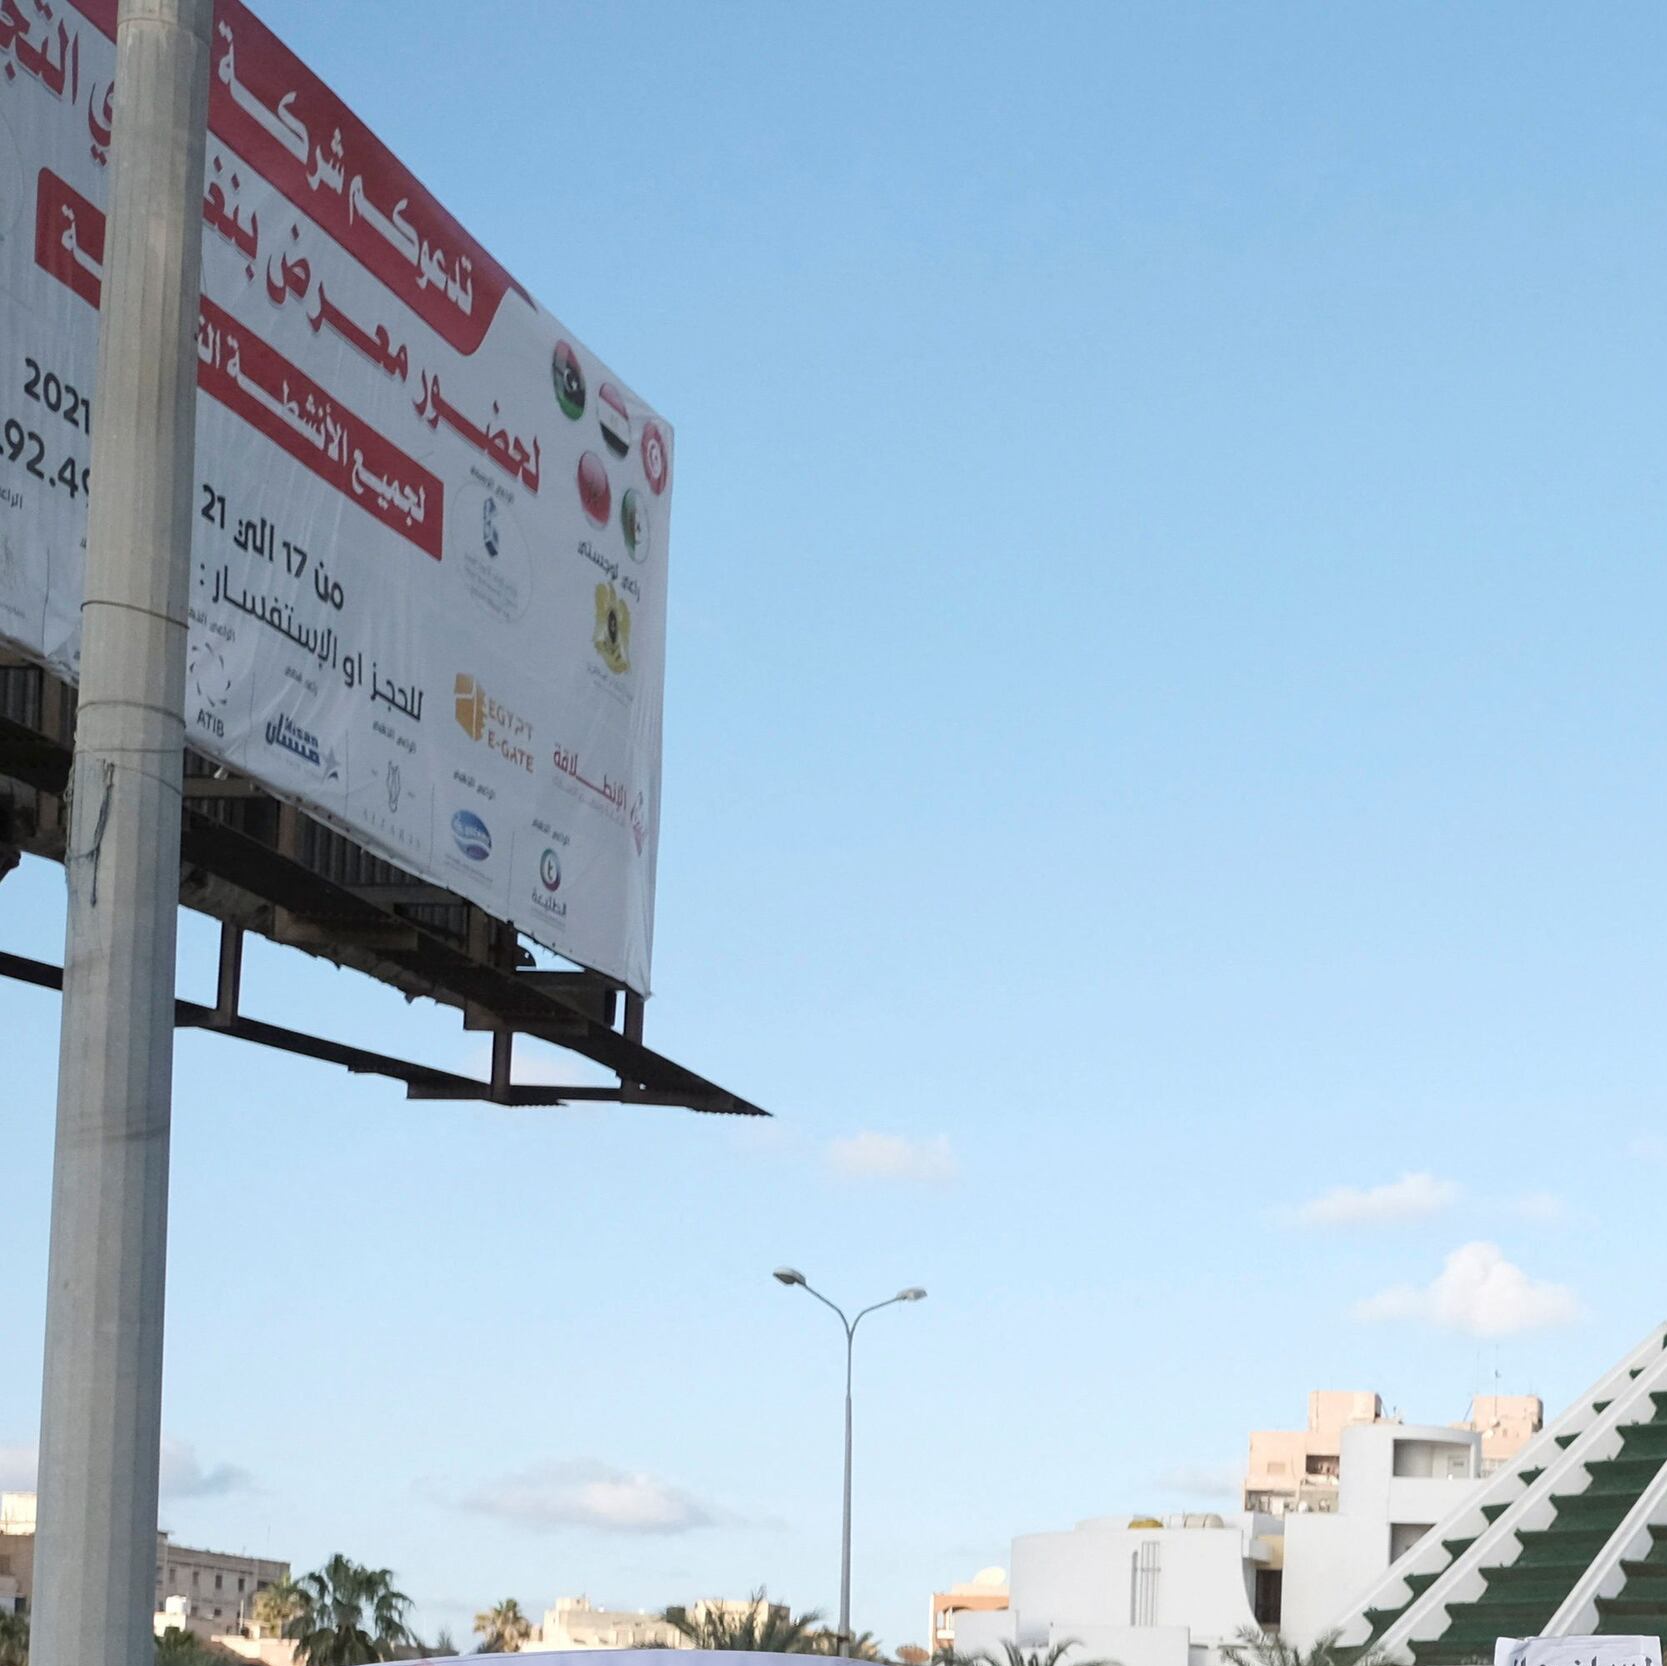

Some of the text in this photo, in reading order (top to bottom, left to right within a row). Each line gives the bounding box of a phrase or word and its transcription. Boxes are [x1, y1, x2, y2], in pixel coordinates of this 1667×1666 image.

[217, 20, 473, 317] تدعوكم شركة
[266, 223, 410, 384] معرض
[24, 357, 90, 435] 2021
[226, 335, 348, 467] الأنشطة
[413, 367, 541, 496] لحضور
[201, 483, 226, 529] 21
[351, 448, 425, 527] لجميع
[282, 541, 308, 578] 17
[314, 561, 344, 611] من
[370, 662, 424, 722] للحجز
[488, 699, 533, 741] EGYPT
[197, 708, 225, 738] ATIB
[488, 728, 534, 774] E-GATE
